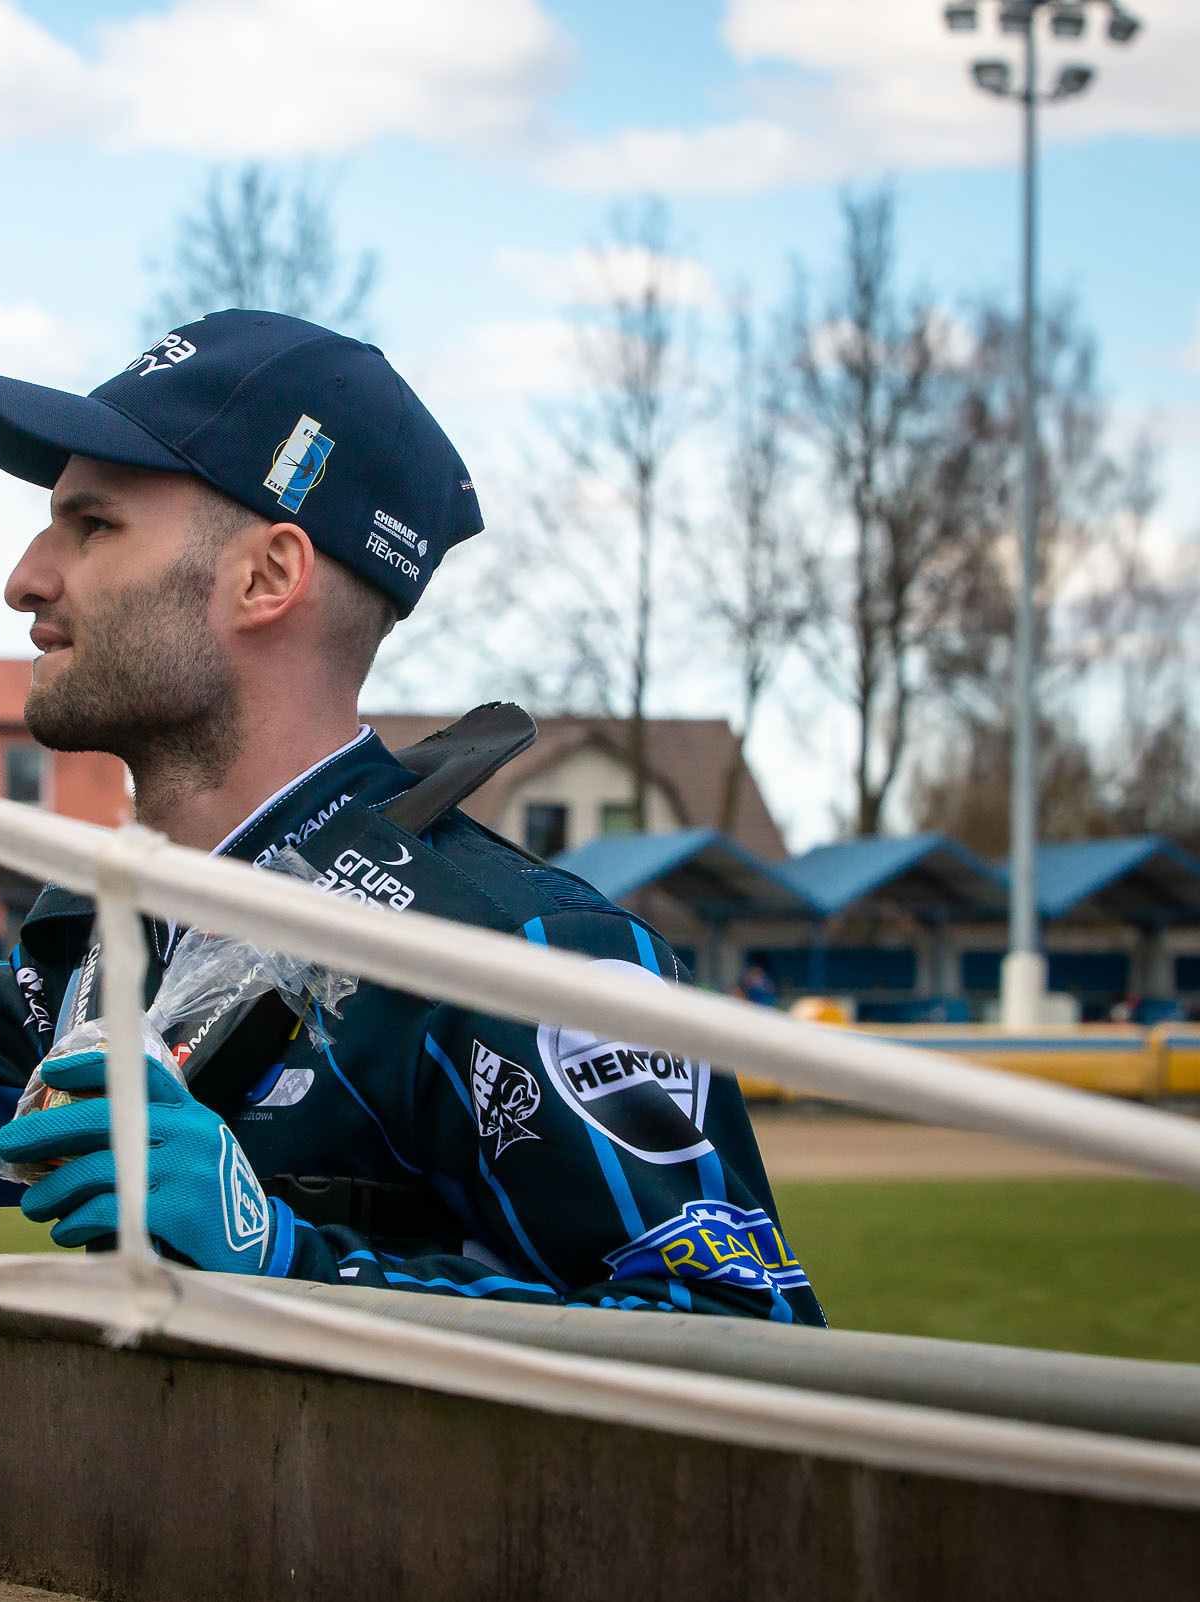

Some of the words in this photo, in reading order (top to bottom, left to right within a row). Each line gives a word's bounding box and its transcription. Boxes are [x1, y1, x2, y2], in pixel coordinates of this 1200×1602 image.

[374, 509, 418, 543] CHEMART
[365, 535, 420, 582] HEKTOR
[74, 942, 101, 1029] CHEMAR
[564, 1048, 689, 1093] HEKTOR
